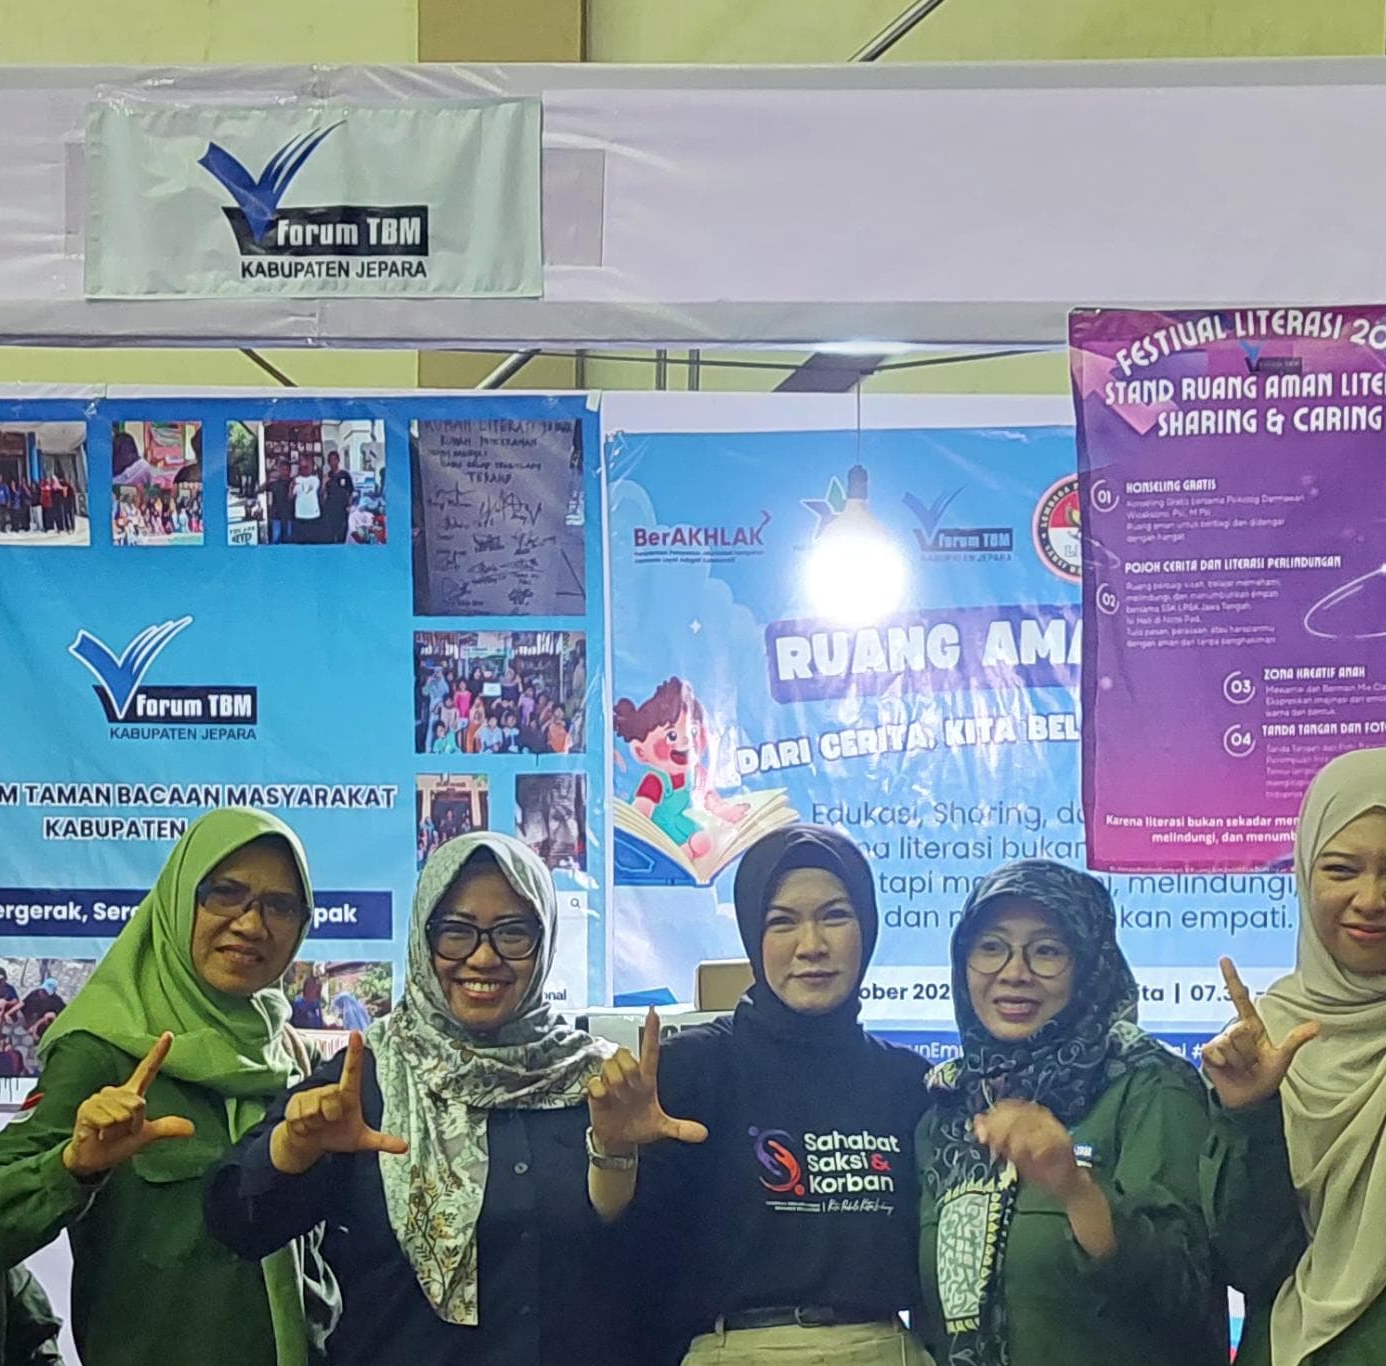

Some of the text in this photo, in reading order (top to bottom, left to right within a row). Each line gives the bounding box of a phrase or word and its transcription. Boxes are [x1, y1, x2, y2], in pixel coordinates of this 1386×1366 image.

[277, 218, 420, 246] Forum TBM
[242, 261, 427, 278] KABUPATEN JEPARA
[1236, 310, 1342, 340] LITERASI
[1106, 379, 1174, 405] STAND
[1182, 375, 1257, 400] RUANG
[1265, 373, 1333, 398] AMAN
[1158, 406, 1383, 437] SHARING & CARING
[1098, 490, 1111, 503] 01
[1183, 479, 1216, 491] GRATIS
[634, 524, 766, 547] BerAKHLAK
[1163, 556, 1341, 573] CERITA DAN LITERASI PERLINDUNGAN
[1102, 594, 1115, 606] 02
[775, 622, 961, 681] RUANG
[1231, 680, 1251, 693] 03
[1264, 668, 1294, 680] ZONA
[136, 694, 252, 717] Forum TBM
[110, 728, 256, 740] KABUPATEN JEPARA
[737, 737, 811, 776] DARI
[820, 720, 937, 760] CERITA,
[945, 713, 1017, 747] KITA
[1231, 732, 1251, 746] 04
[1262, 724, 1295, 736] TANDA
[1299, 723, 1337, 735] TANGAN
[1341, 722, 1362, 734] DAN
[25, 784, 111, 807] TAMAN
[117, 785, 220, 808] BACAAN
[227, 786, 397, 809] MASYARAKAT
[813, 800, 1047, 832] Edukasi, Sharing,
[1106, 814, 1271, 828] Karena literasi bukan sekadar
[43, 817, 187, 840] KABUPATEN
[1152, 830, 1219, 845] melindungi,
[1222, 830, 1243, 844] dan
[899, 837, 993, 862] literasi
[879, 871, 935, 902] tapi
[1128, 873, 1298, 902] melindungi,
[885, 904, 939, 928] dan
[1182, 905, 1294, 935] empati.
[913, 983, 951, 1002] 202
[803, 1130, 900, 1153] Sahabat
[807, 1152, 891, 1172] Saksi &
[809, 1174, 894, 1195] Korban
